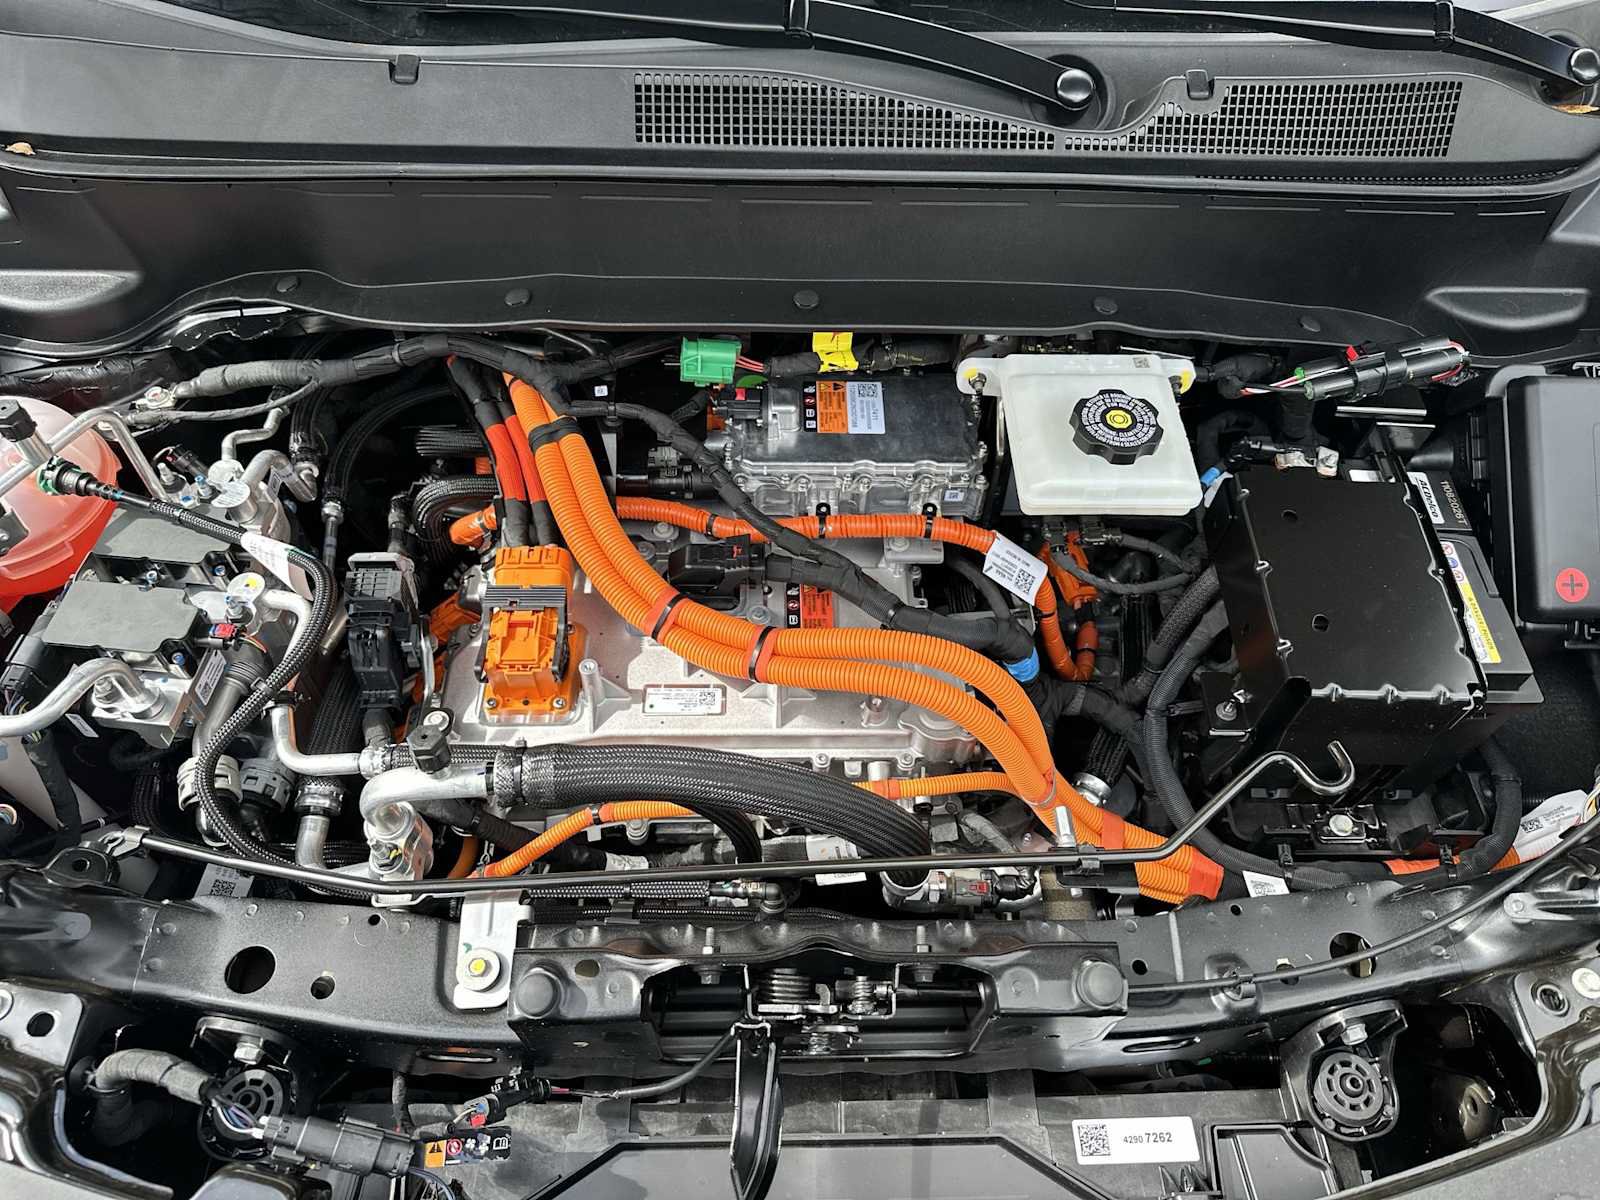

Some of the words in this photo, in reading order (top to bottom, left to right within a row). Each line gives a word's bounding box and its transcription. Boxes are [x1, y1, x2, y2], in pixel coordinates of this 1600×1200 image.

[1418, 479, 1440, 518] ACDelco
[1123, 1134, 1144, 1144] 4290
[1144, 1131, 1173, 1143] 7262
